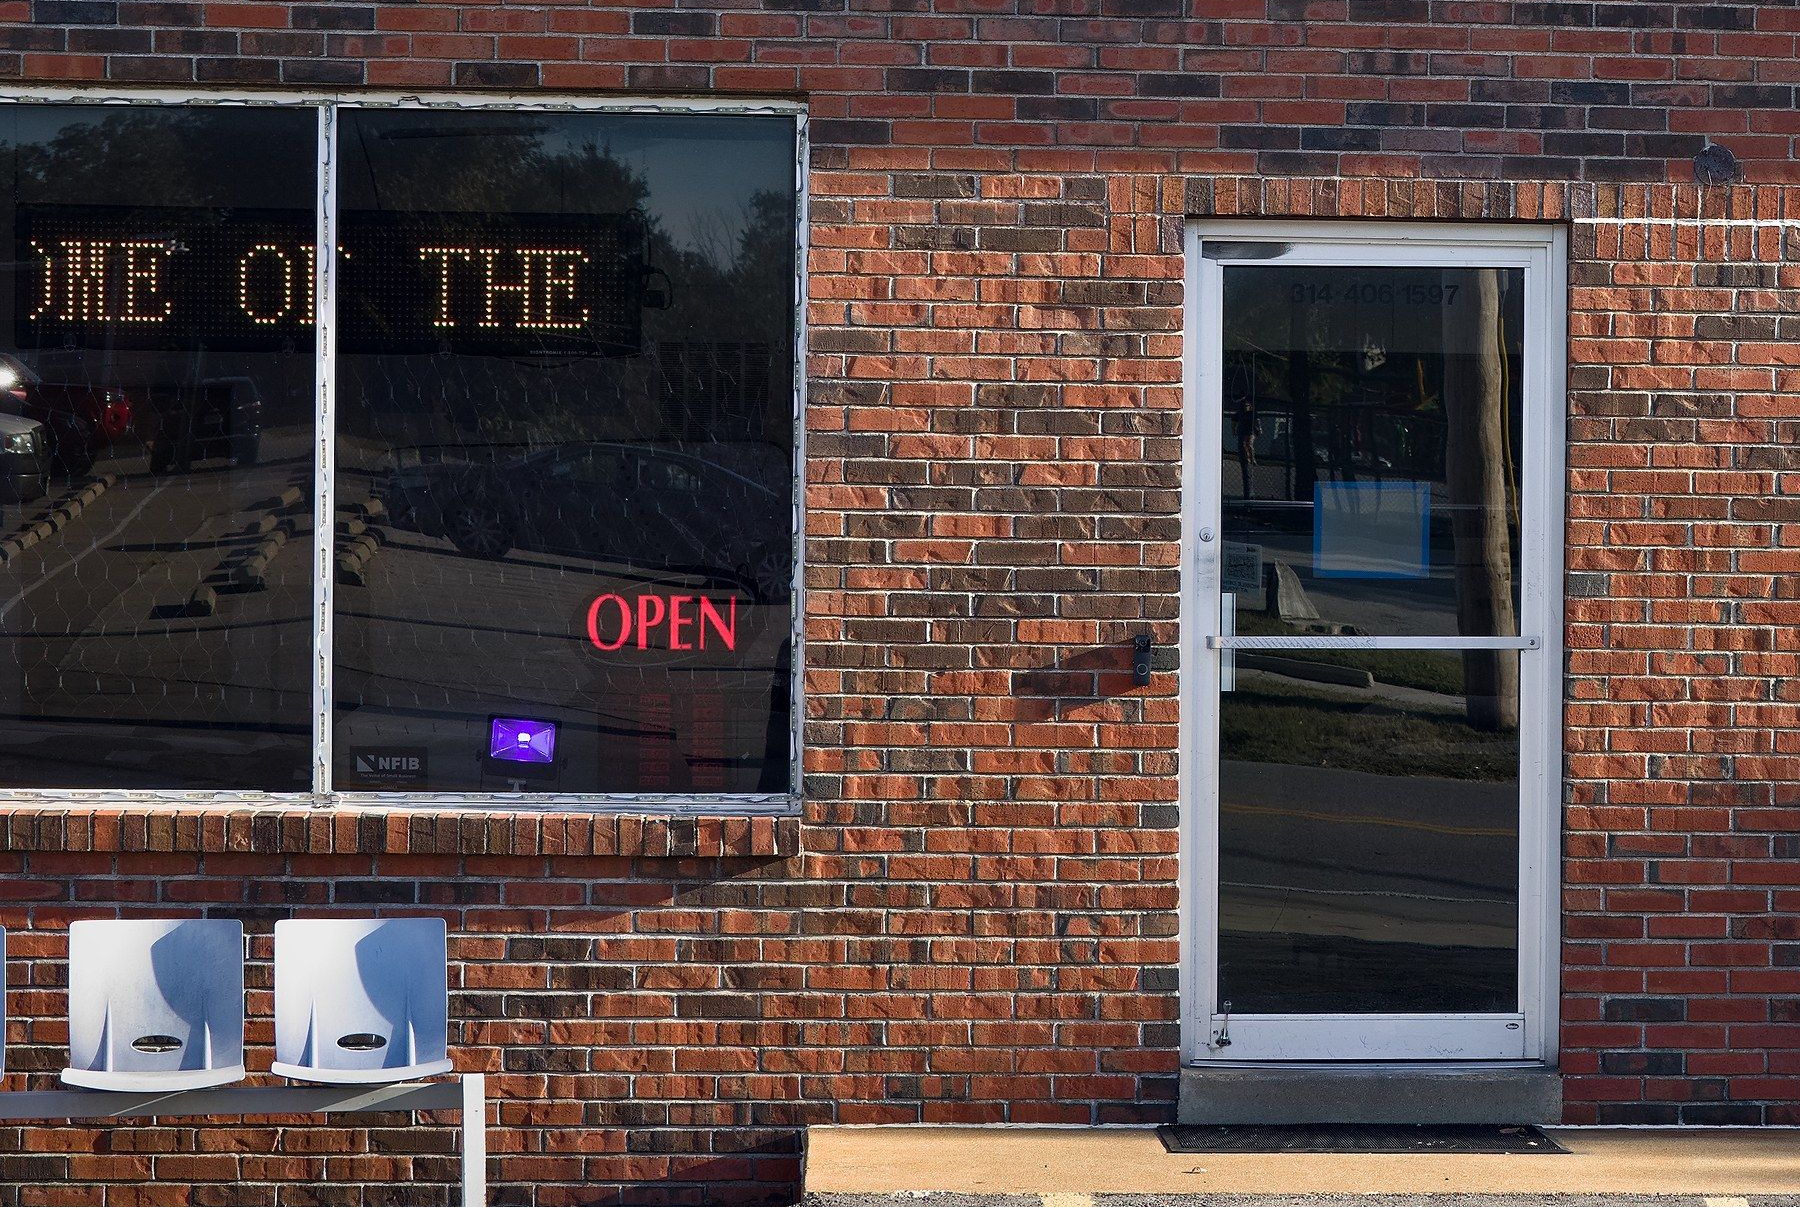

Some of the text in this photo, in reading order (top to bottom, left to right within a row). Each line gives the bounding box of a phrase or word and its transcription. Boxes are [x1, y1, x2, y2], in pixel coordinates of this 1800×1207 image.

[418, 246, 589, 328] THE
[586, 593, 737, 652] OPEN
[378, 756, 420, 771] NFIB
